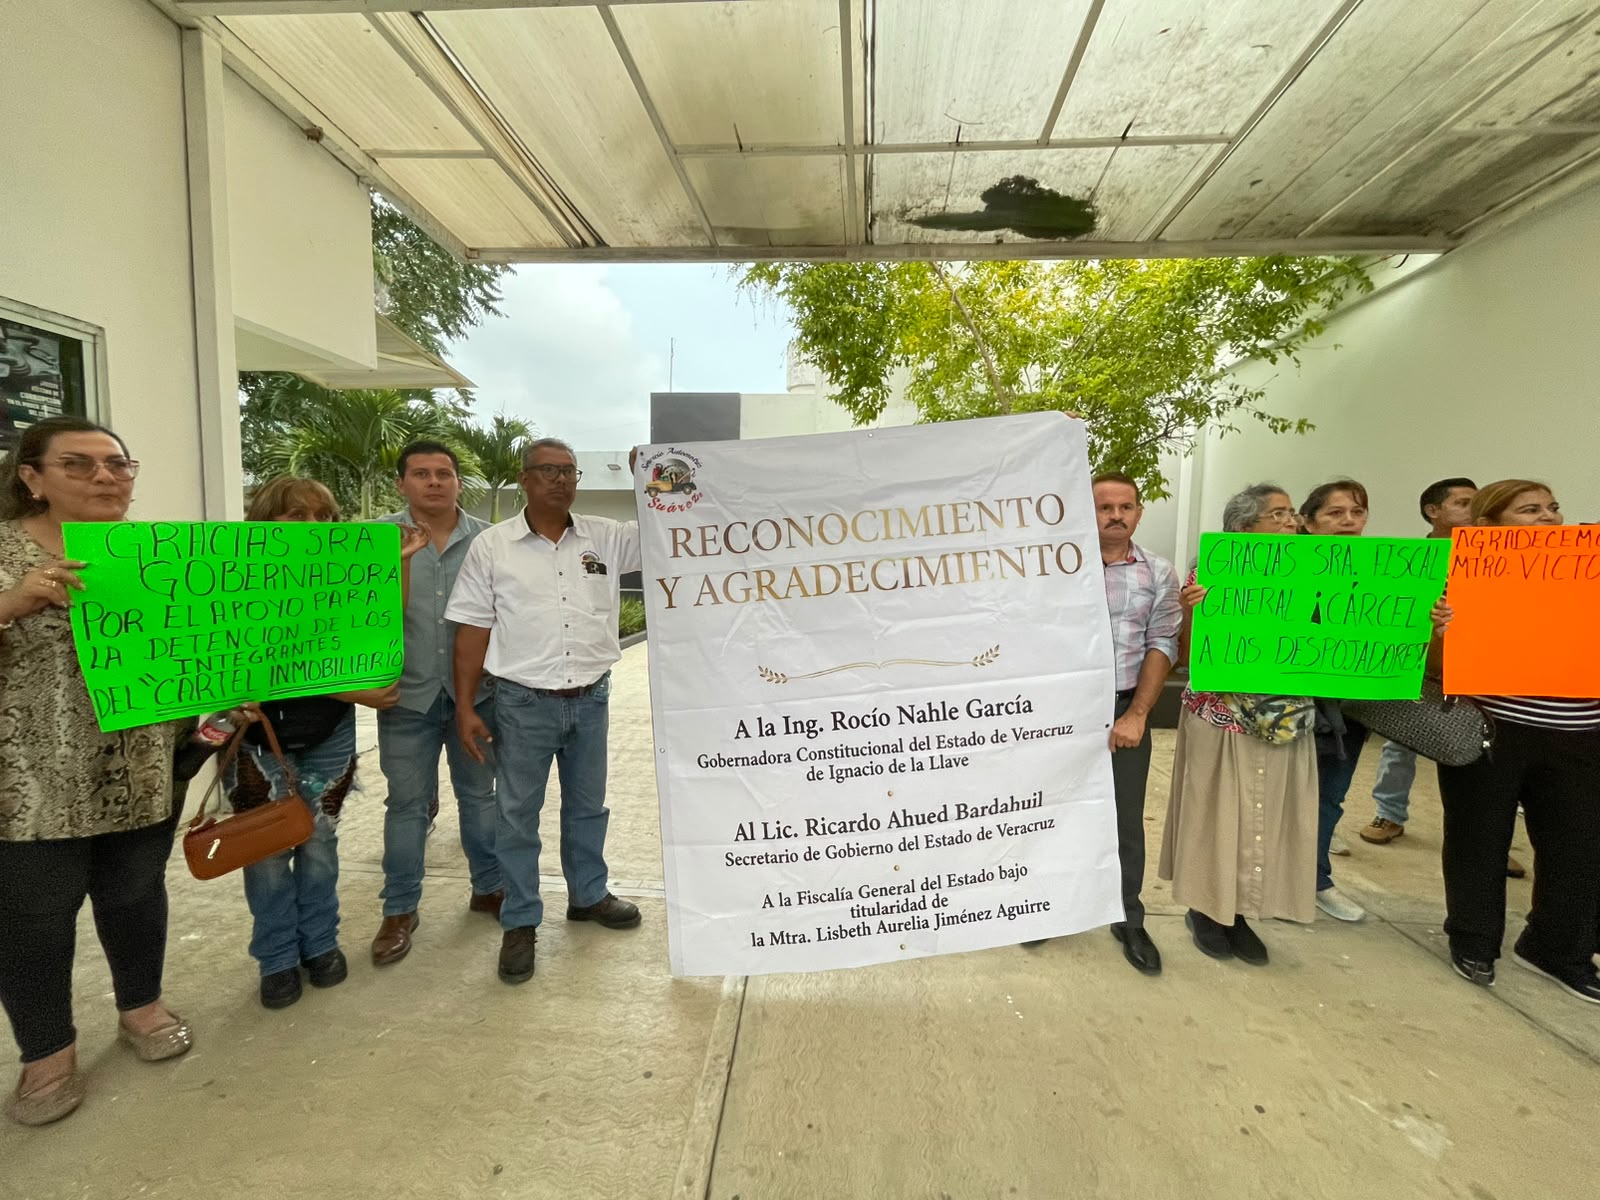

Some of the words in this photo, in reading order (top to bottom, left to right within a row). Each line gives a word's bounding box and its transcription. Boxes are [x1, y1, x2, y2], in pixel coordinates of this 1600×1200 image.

[641, 451, 664, 471] Servicio
[647, 492, 704, 513] Suárez
[106, 522, 290, 560] GRACIAS
[305, 526, 374, 555] SRA
[667, 493, 1065, 558] RECONOCIMIENTO
[140, 558, 400, 602] GOBERNADORA
[656, 576, 682, 609] Y
[693, 541, 1083, 607] AGRADECIMIENTO
[1207, 538, 1297, 577] GRACIAS
[1312, 543, 1358, 577] SRA.
[1373, 544, 1438, 581] FISCAL
[82, 601, 143, 641] POR
[164, 604, 200, 629] EL
[211, 597, 303, 624] APOYO
[314, 589, 378, 610] PARA
[1201, 585, 1295, 622] GENERAL
[1310, 581, 1416, 629] ¡CÁRCEL
[91, 646, 122, 670] LA
[144, 623, 299, 661] DETENCION
[311, 617, 341, 636] DE
[351, 610, 392, 628] LOS
[174, 636, 341, 677] INTEGRANTES
[1199, 634, 1213, 666] A
[1224, 631, 1261, 665] LOS
[1274, 635, 1430, 675] DESPOJADORES!
[93, 685, 146, 719] DEL
[734, 719, 751, 740] A
[757, 717, 776, 738] la
[782, 715, 824, 739] Ing.
[831, 707, 891, 732] Rocío
[896, 701, 960, 725] Nahle
[965, 694, 1034, 719] García
[697, 750, 792, 769] Gobernadora
[796, 738, 905, 762] Constitucional
[909, 736, 931, 752] del
[936, 731, 985, 750] Estado
[990, 729, 1008, 744] de
[1012, 724, 1074, 742] Veracruz
[806, 766, 824, 782] de
[829, 761, 884, 783] Ignacio
[888, 758, 906, 774] de
[911, 757, 924, 772] la
[929, 754, 969, 770] Llave
[734, 821, 756, 841] Al
[761, 820, 798, 840] Lic.
[805, 813, 881, 837] Ricardo
[887, 804, 949, 829] Ahued
[955, 791, 1044, 821] Bardahuil
[725, 849, 798, 867] Secretario
[803, 846, 821, 862] de
[825, 842, 893, 860] Gobierno
[898, 836, 919, 852] del
[924, 830, 972, 849] Estado
[976, 826, 993, 842] de
[997, 818, 1055, 838] Veracruz
[762, 894, 774, 909] A
[779, 892, 792, 907] la
[797, 887, 853, 906] Fiscalía
[858, 879, 916, 899] General
[920, 875, 942, 892] del
[947, 868, 995, 888] Estado
[998, 863, 1028, 882] bajo
[850, 895, 928, 919] titularidad
[932, 893, 949, 909] de
[751, 932, 765, 948] la
[769, 931, 811, 946] Mtra.
[816, 922, 872, 942] Lisbeth
[876, 915, 930, 935] Aurelia
[934, 909, 992, 931] Jiménez
[996, 899, 1051, 921] Aguirre
